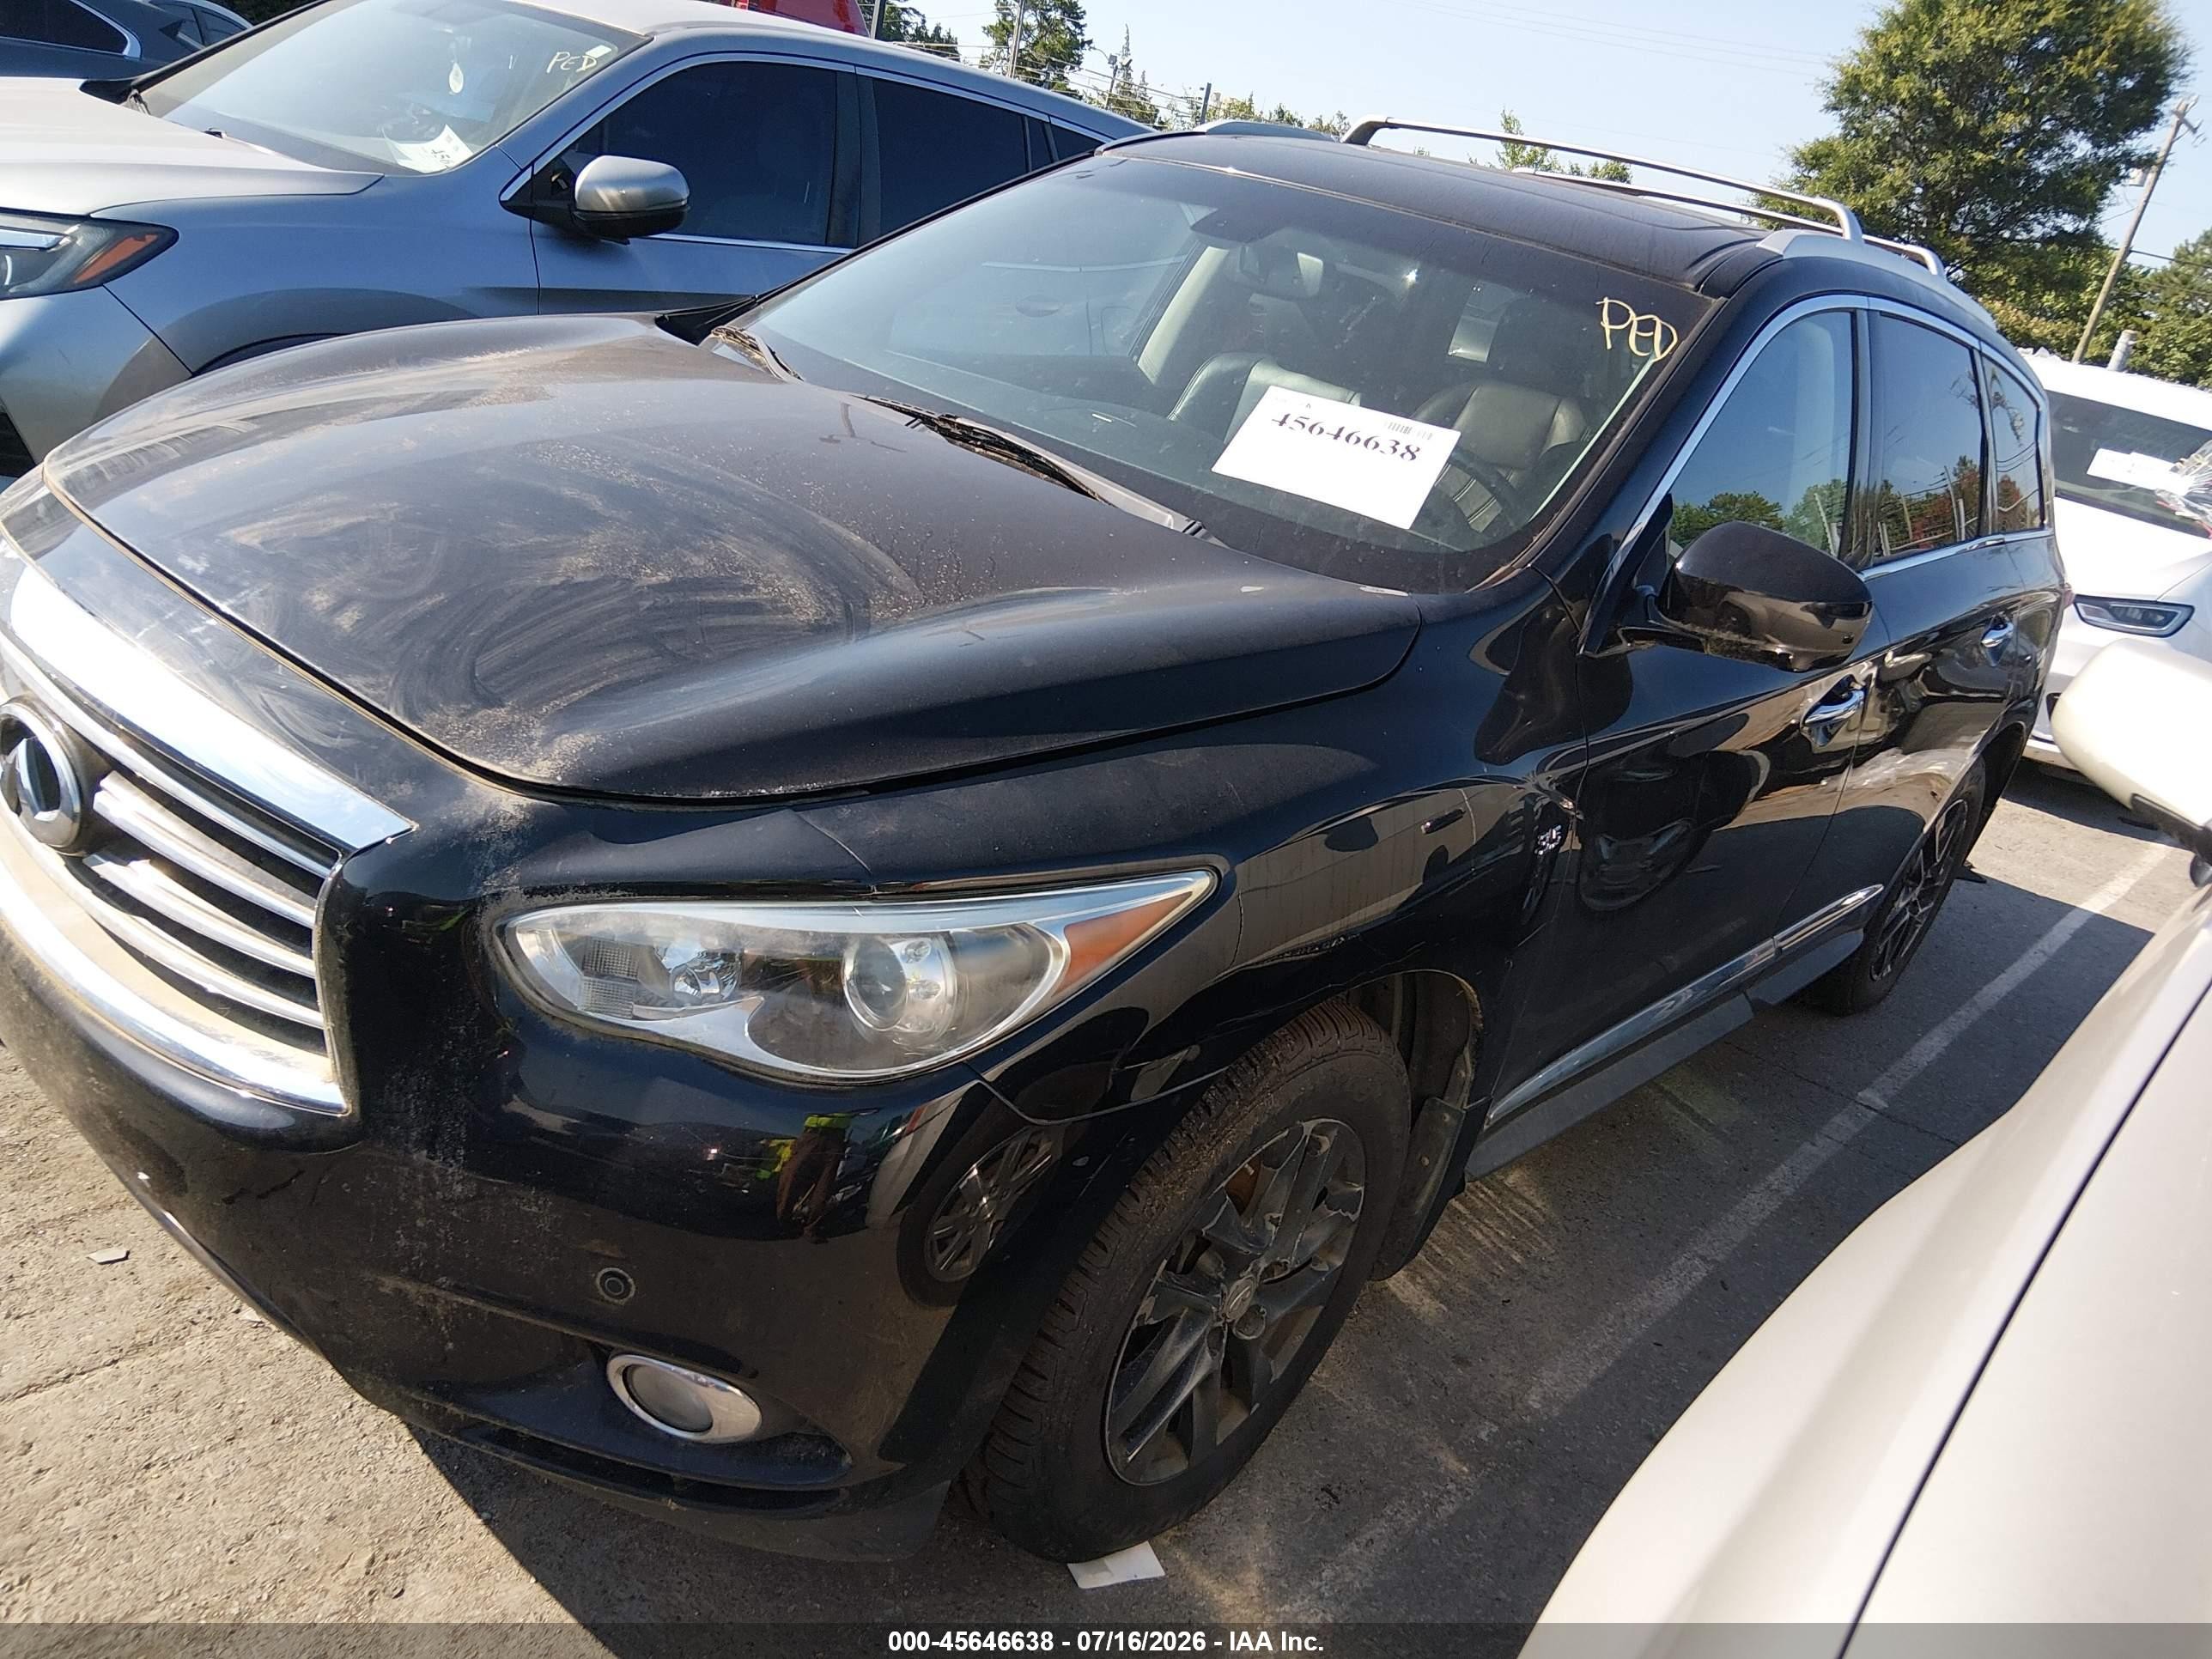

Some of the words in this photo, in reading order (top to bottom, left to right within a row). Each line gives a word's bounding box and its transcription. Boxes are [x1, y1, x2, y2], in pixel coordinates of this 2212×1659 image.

[546, 52, 598, 74] PED
[1595, 296, 1679, 362] PED
[1272, 413, 1421, 461] 45646638
